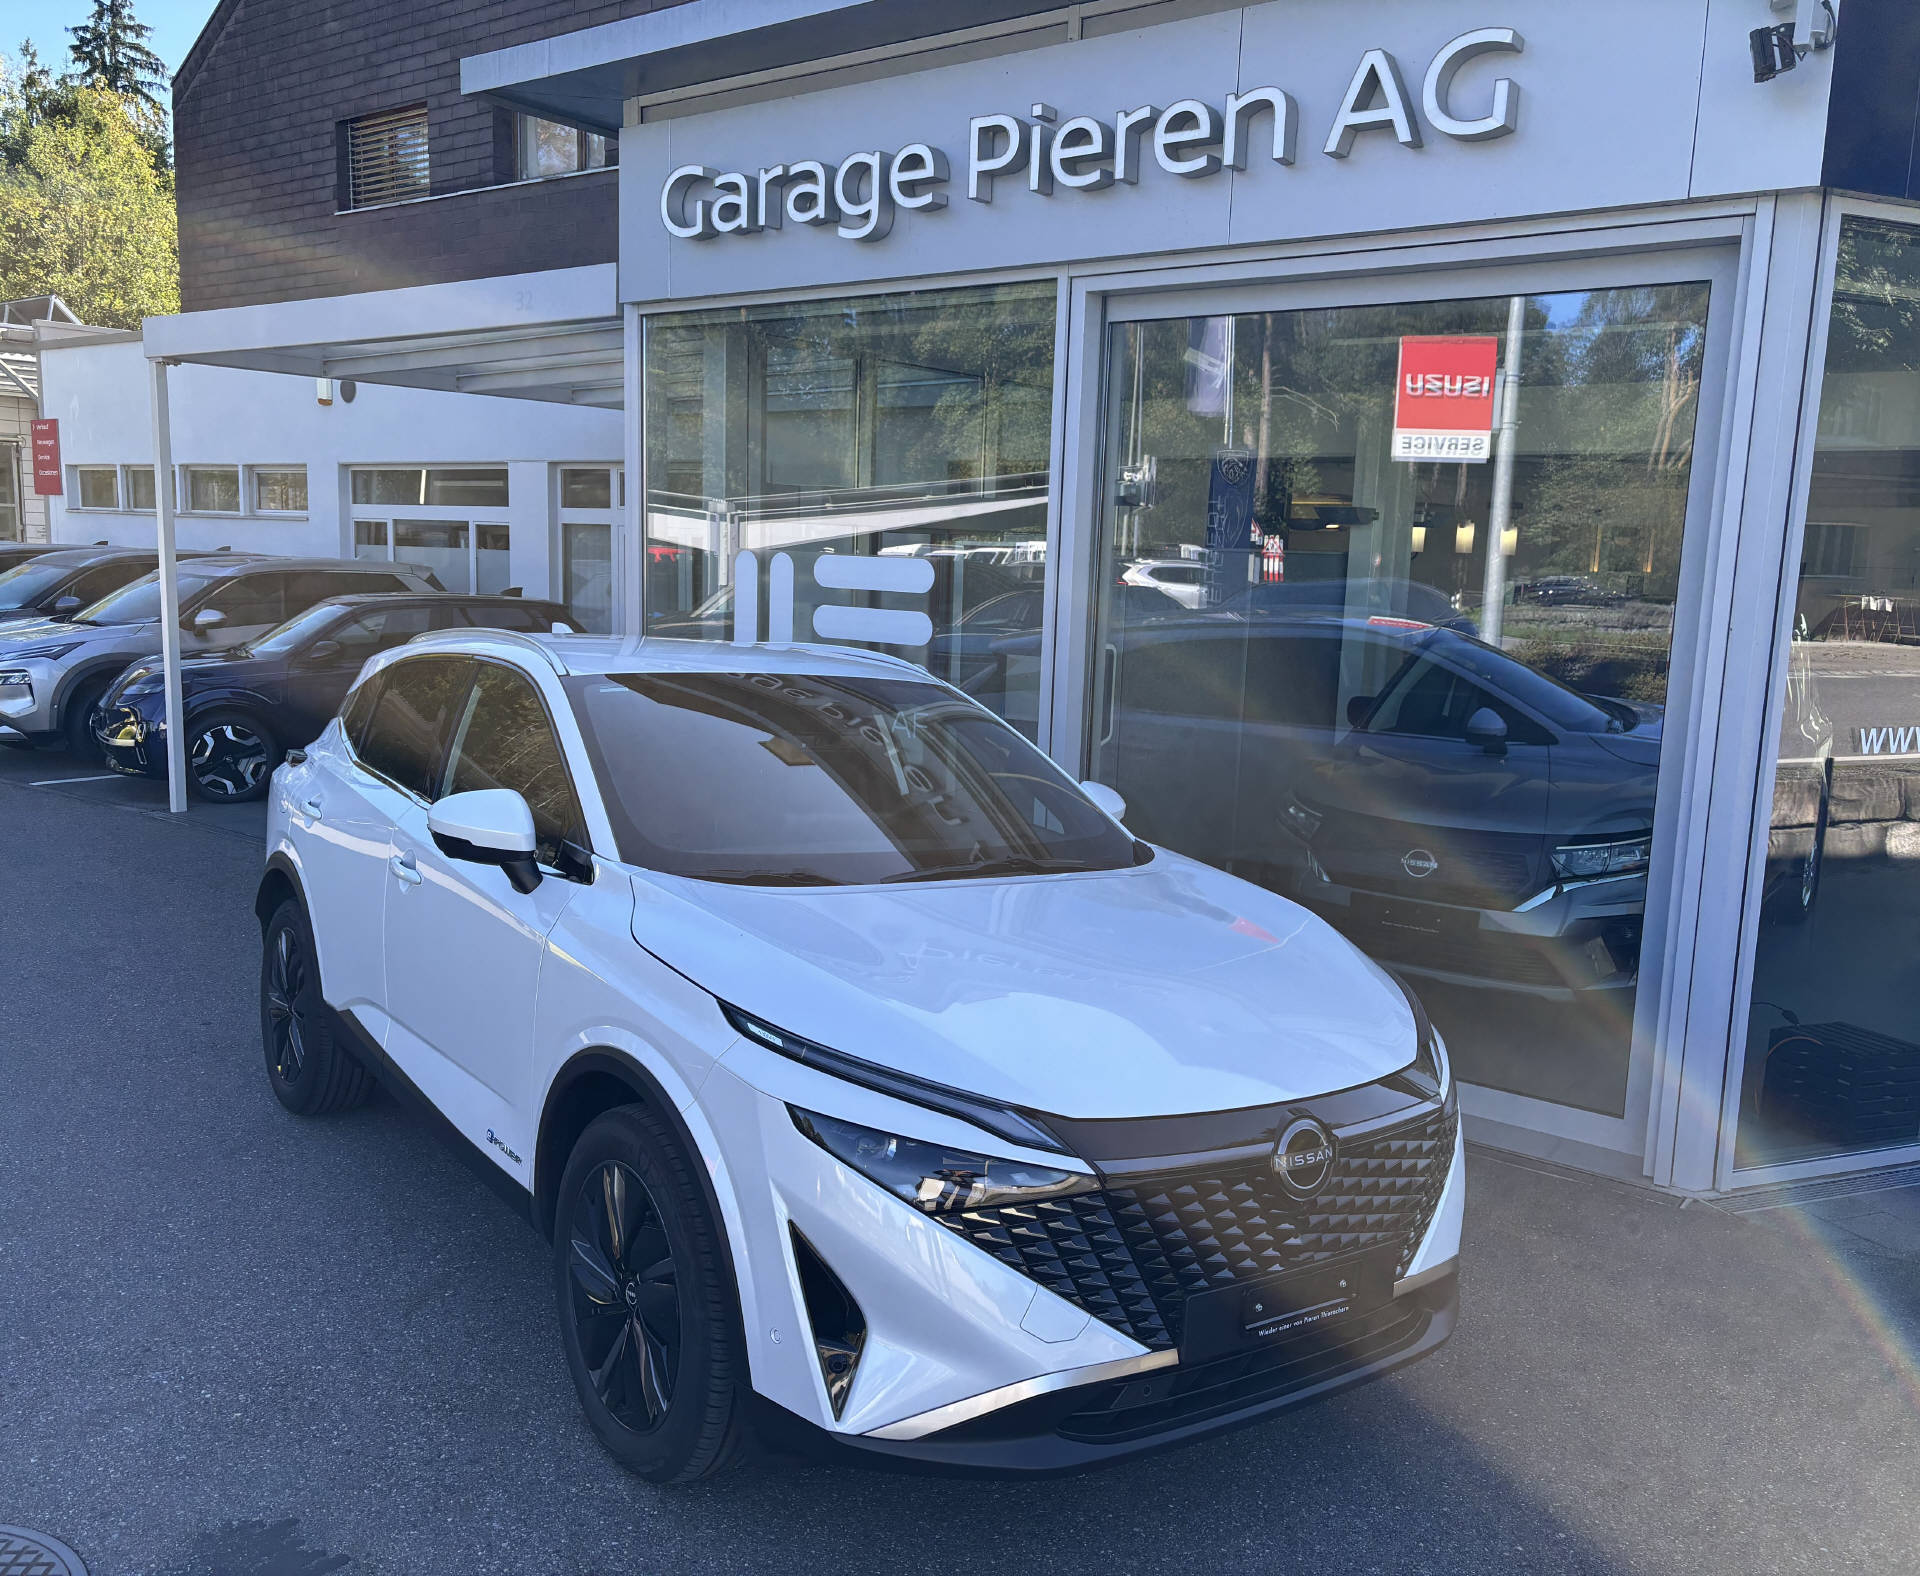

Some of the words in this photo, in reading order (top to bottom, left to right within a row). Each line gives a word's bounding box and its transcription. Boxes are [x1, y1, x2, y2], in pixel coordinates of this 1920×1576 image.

[660, 142, 950, 243] Garage
[967, 85, 1299, 203] Pieren
[1323, 26, 1525, 160] AG
[1860, 726, 1920, 755] ww
[1273, 1145, 1333, 1169] NISSAN
